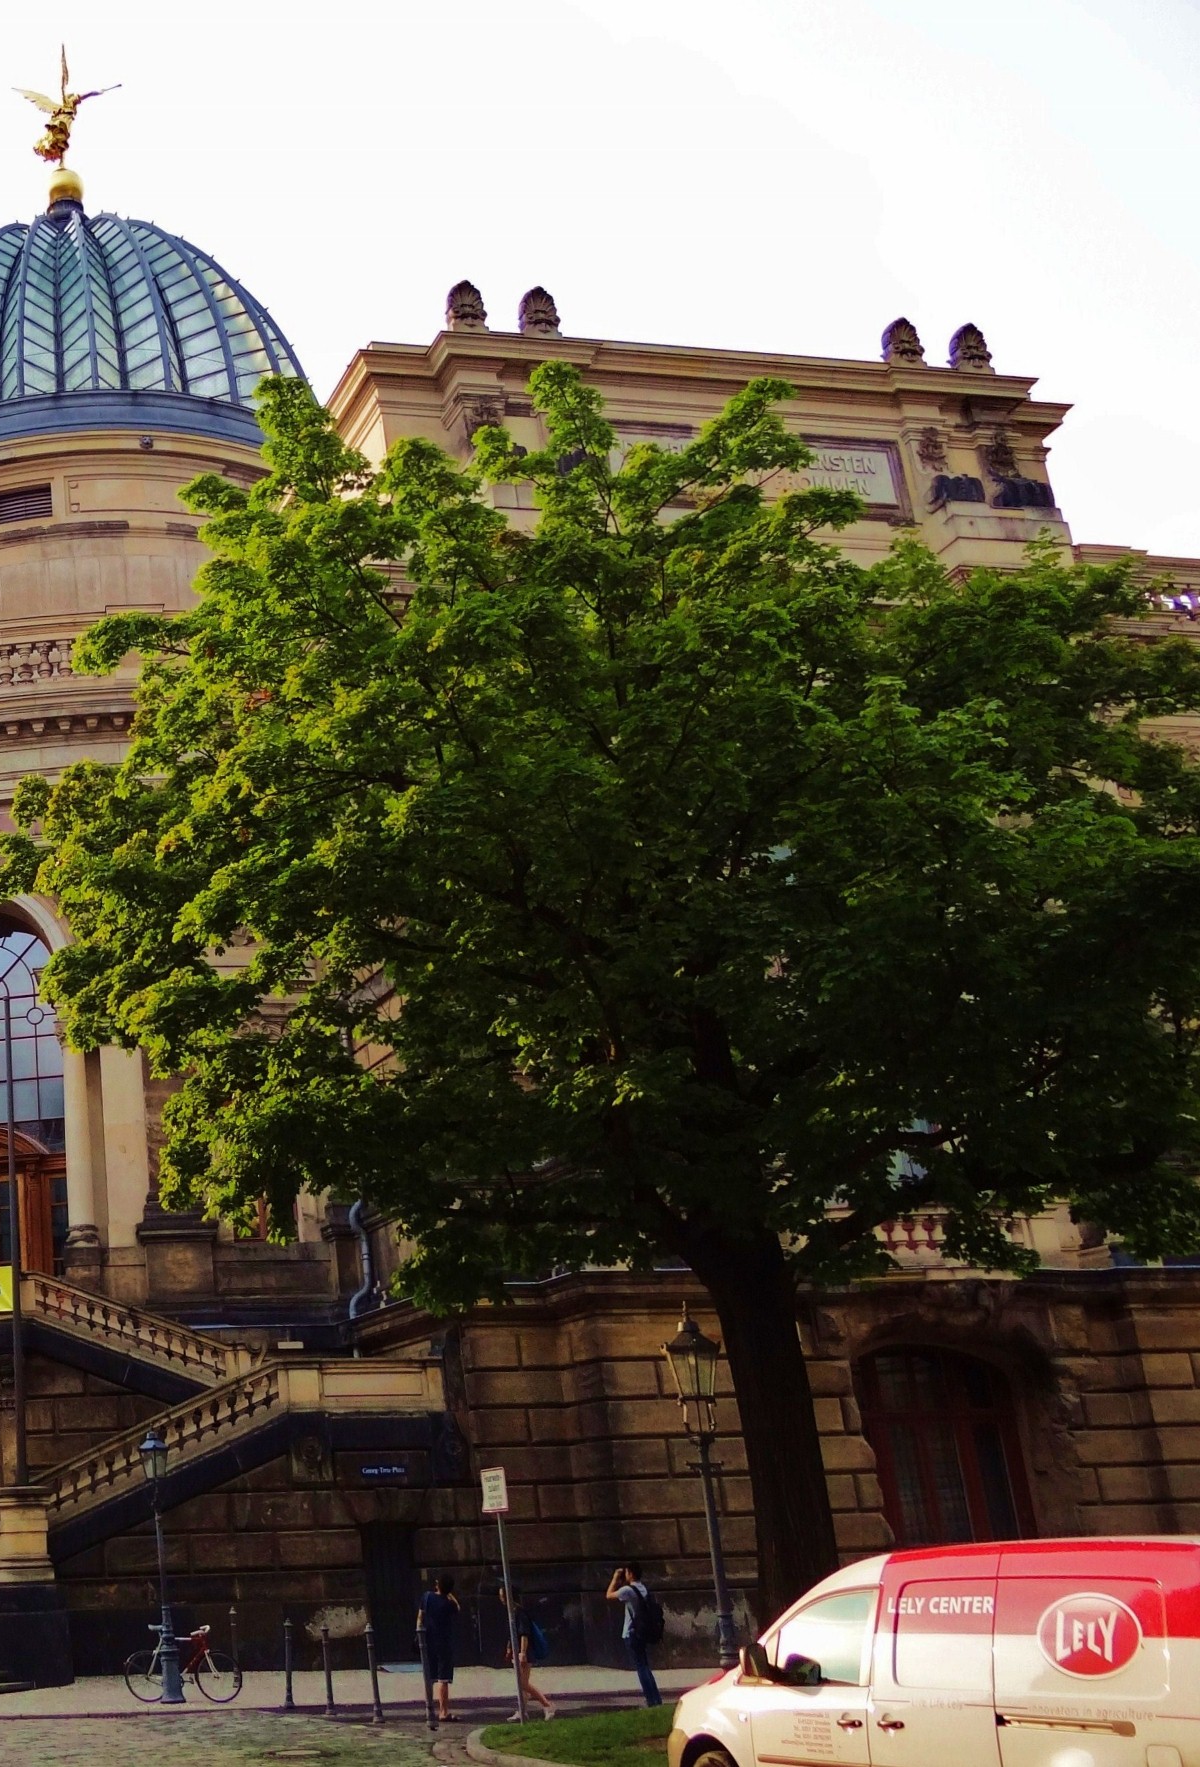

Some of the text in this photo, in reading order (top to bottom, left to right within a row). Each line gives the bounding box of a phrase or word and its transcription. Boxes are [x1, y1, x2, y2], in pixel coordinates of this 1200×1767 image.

[807, 452, 876, 475] ENSTEN
[887, 1596, 994, 1614] LELY CENTER
[1056, 1610, 1118, 1663] LELY
[1096, 1707, 1154, 1721] agriculture
